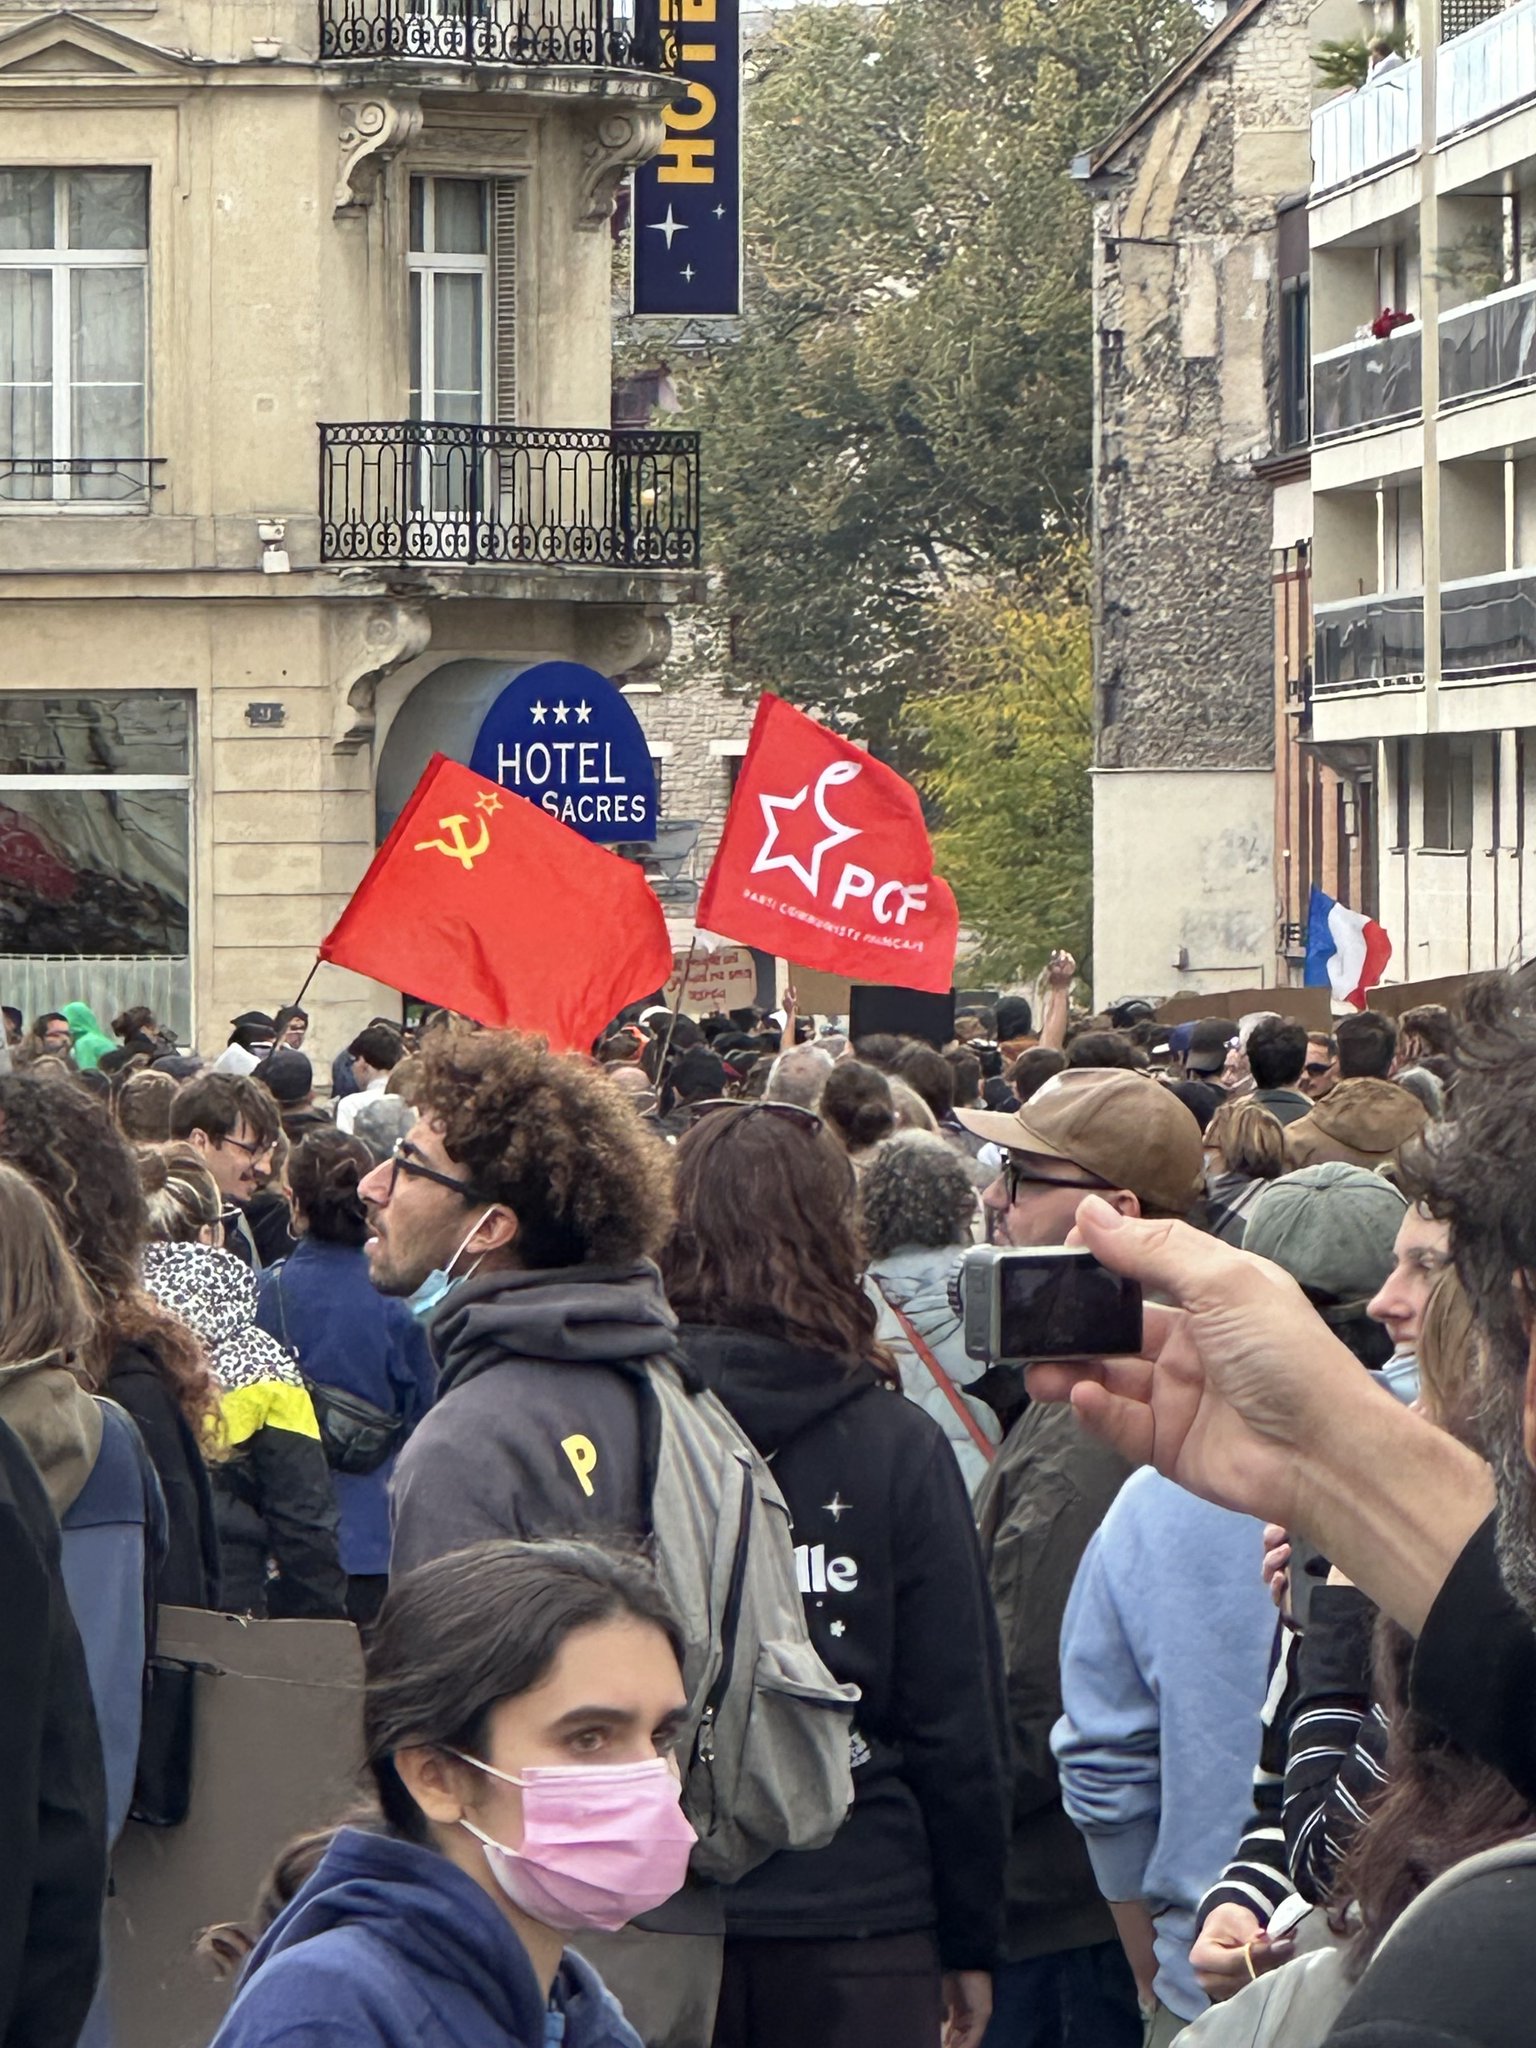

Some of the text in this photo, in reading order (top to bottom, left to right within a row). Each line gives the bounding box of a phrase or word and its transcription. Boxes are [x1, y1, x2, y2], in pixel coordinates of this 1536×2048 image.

[497, 742, 626, 785] HOTEL
[541, 790, 646, 823] SACRES
[831, 862, 929, 926] PCF
[560, 1433, 597, 1497] P
